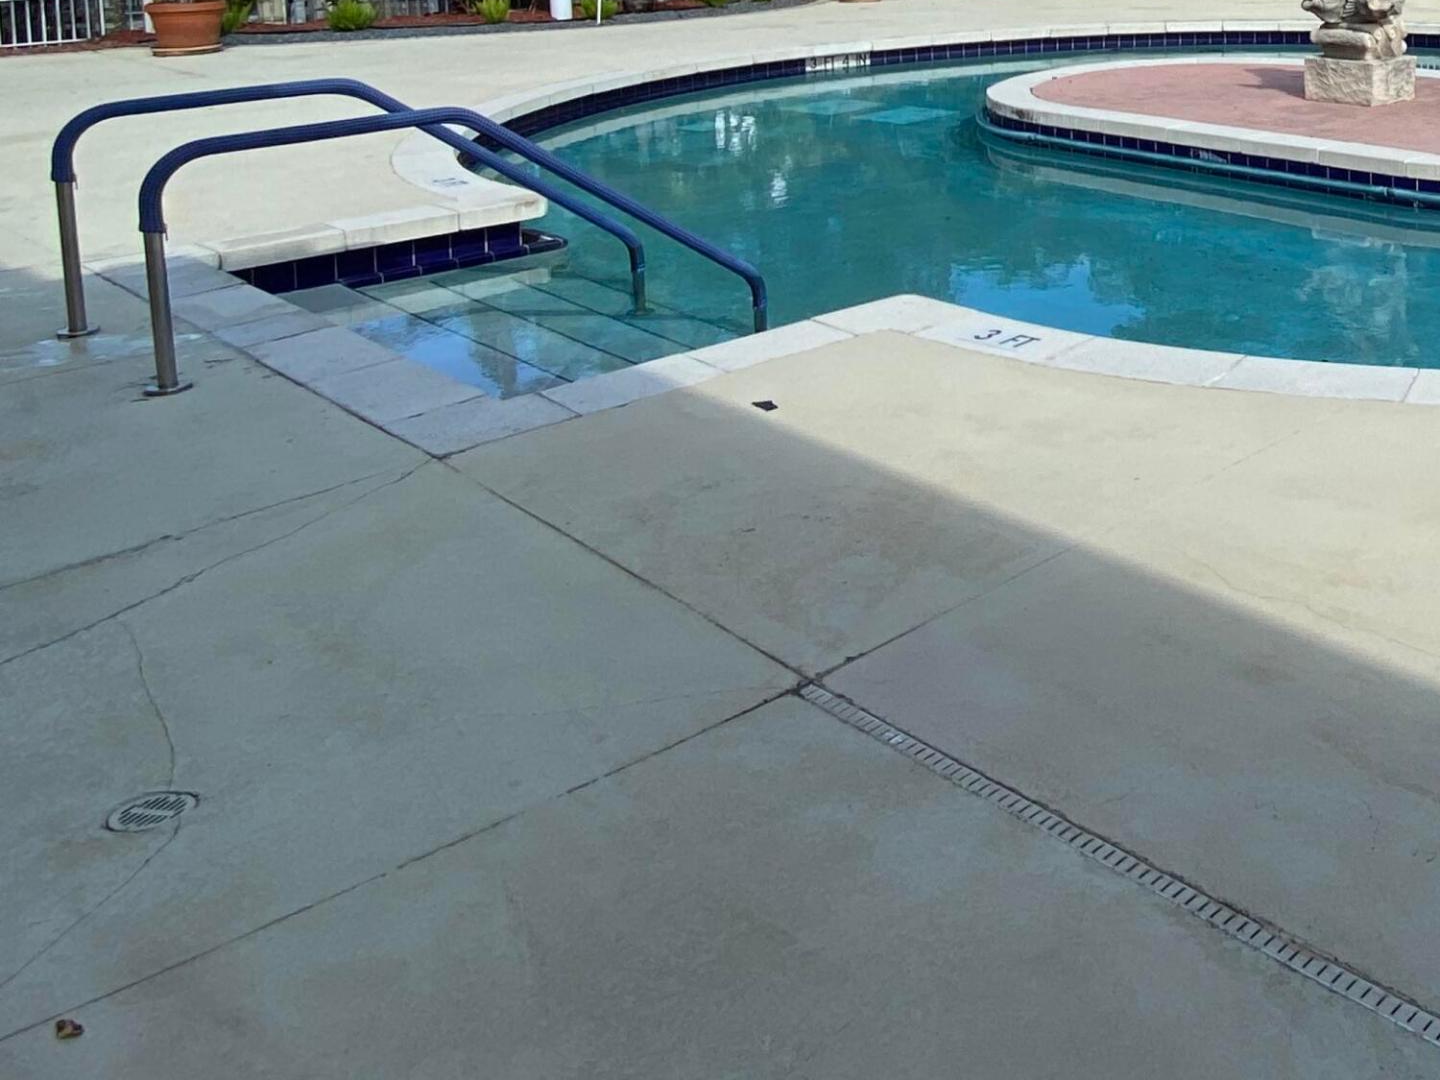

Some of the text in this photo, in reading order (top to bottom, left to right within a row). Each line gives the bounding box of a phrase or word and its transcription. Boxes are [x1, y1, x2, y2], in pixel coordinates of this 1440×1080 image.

[808, 56, 817, 69] 3
[842, 54, 850, 67] 4
[974, 329, 1042, 348] 3 FT
